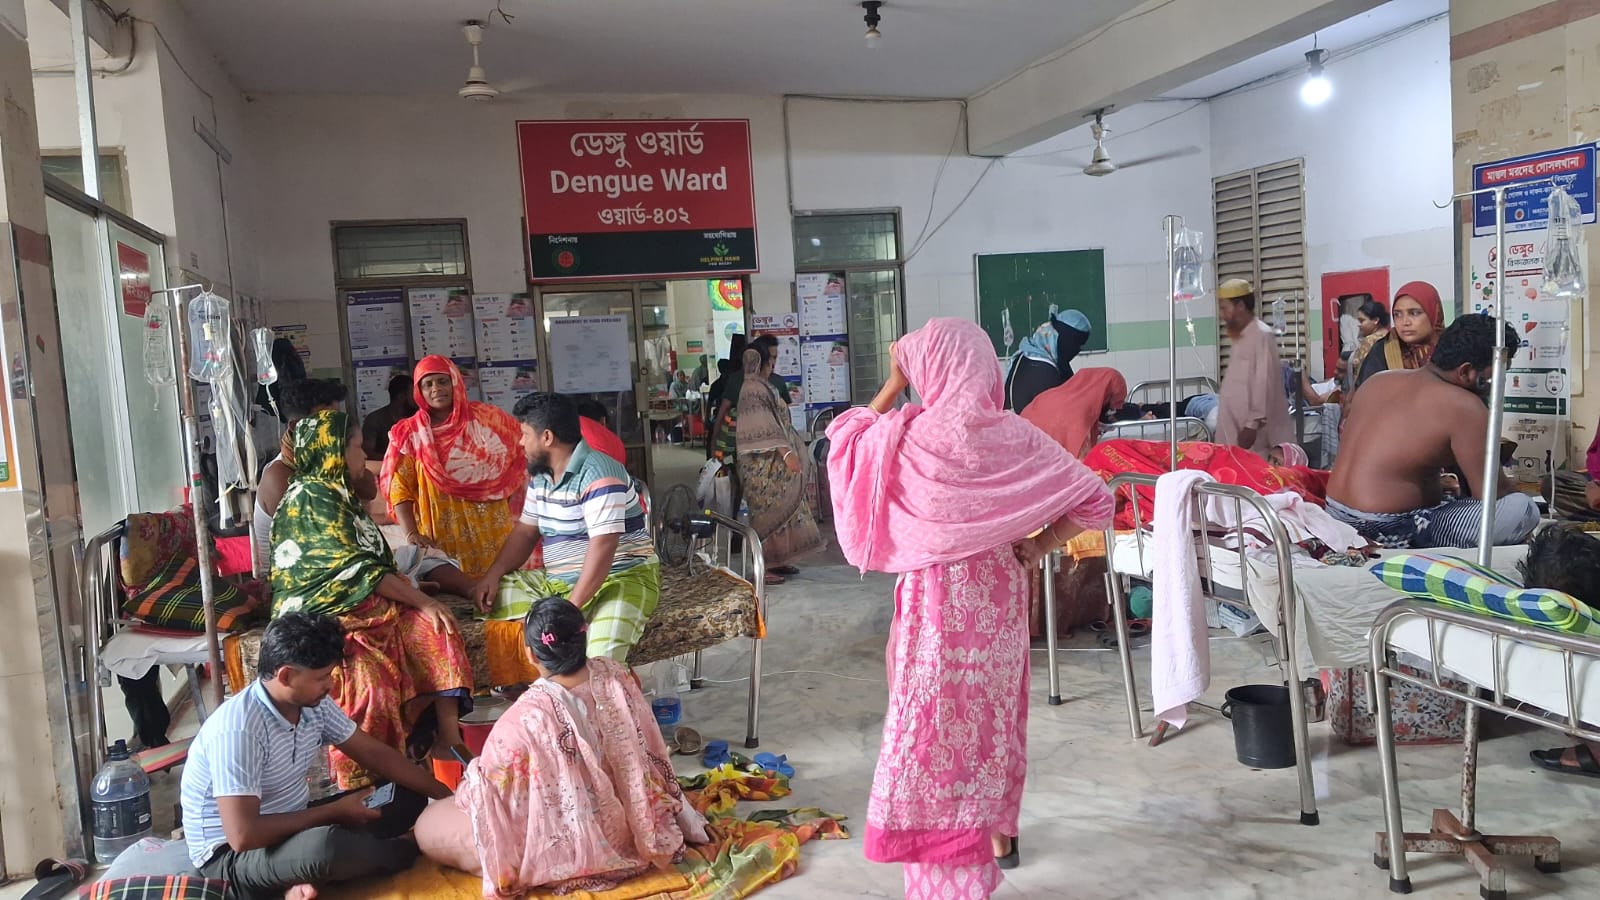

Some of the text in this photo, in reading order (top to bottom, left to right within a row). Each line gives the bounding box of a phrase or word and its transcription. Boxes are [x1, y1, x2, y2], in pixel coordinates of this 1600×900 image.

[570, 122, 704, 168] ডেঙ্গু ওয়ার্ড
[1508, 163, 1535, 177] মরদেহ
[1536, 157, 1579, 173] গোসলখানা
[550, 166, 727, 198] Dengue Ward
[597, 202, 692, 226] ওয়ার্ড-৪০২
[1509, 243, 1534, 257] ডেঙ্গুর
